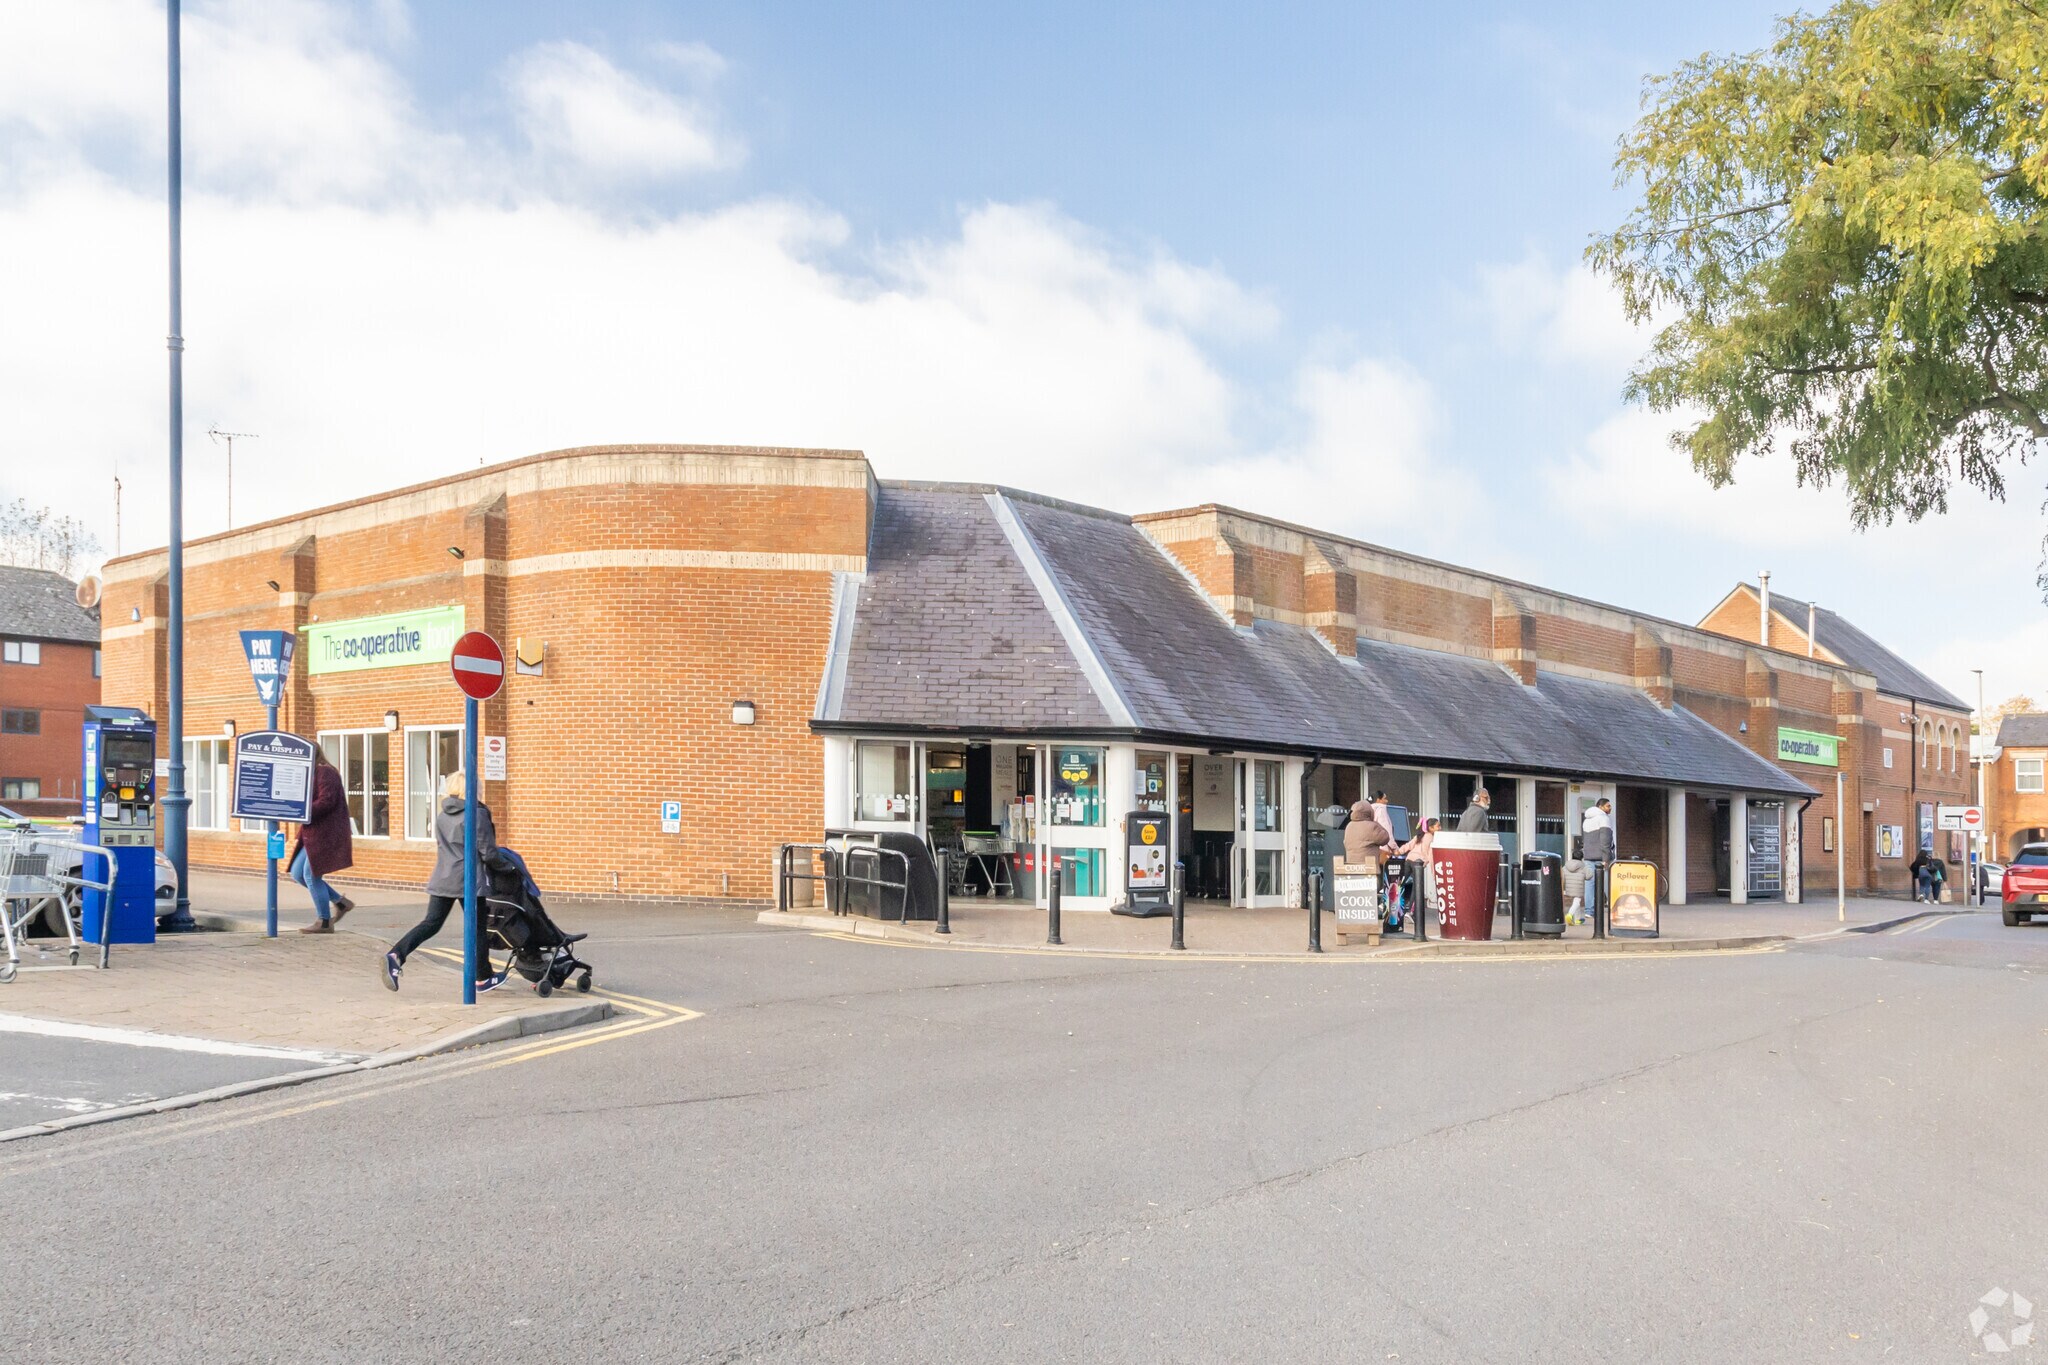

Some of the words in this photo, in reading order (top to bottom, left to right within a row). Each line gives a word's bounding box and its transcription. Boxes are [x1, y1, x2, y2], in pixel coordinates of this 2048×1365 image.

[251, 639, 271, 655] PAY
[323, 635, 341, 661] The
[250, 658, 278, 674] HERE
[271, 746, 304, 755] DISPLAY
[666, 803, 679, 819] P
[1344, 864, 1366, 872] COOK
[1617, 872, 1649, 880] Rollover
[1434, 861, 1447, 925] COSTA
[1446, 861, 1457, 918] EXPRESS
[1340, 896, 1373, 907] COOK
[1338, 909, 1376, 920] INSIDE
